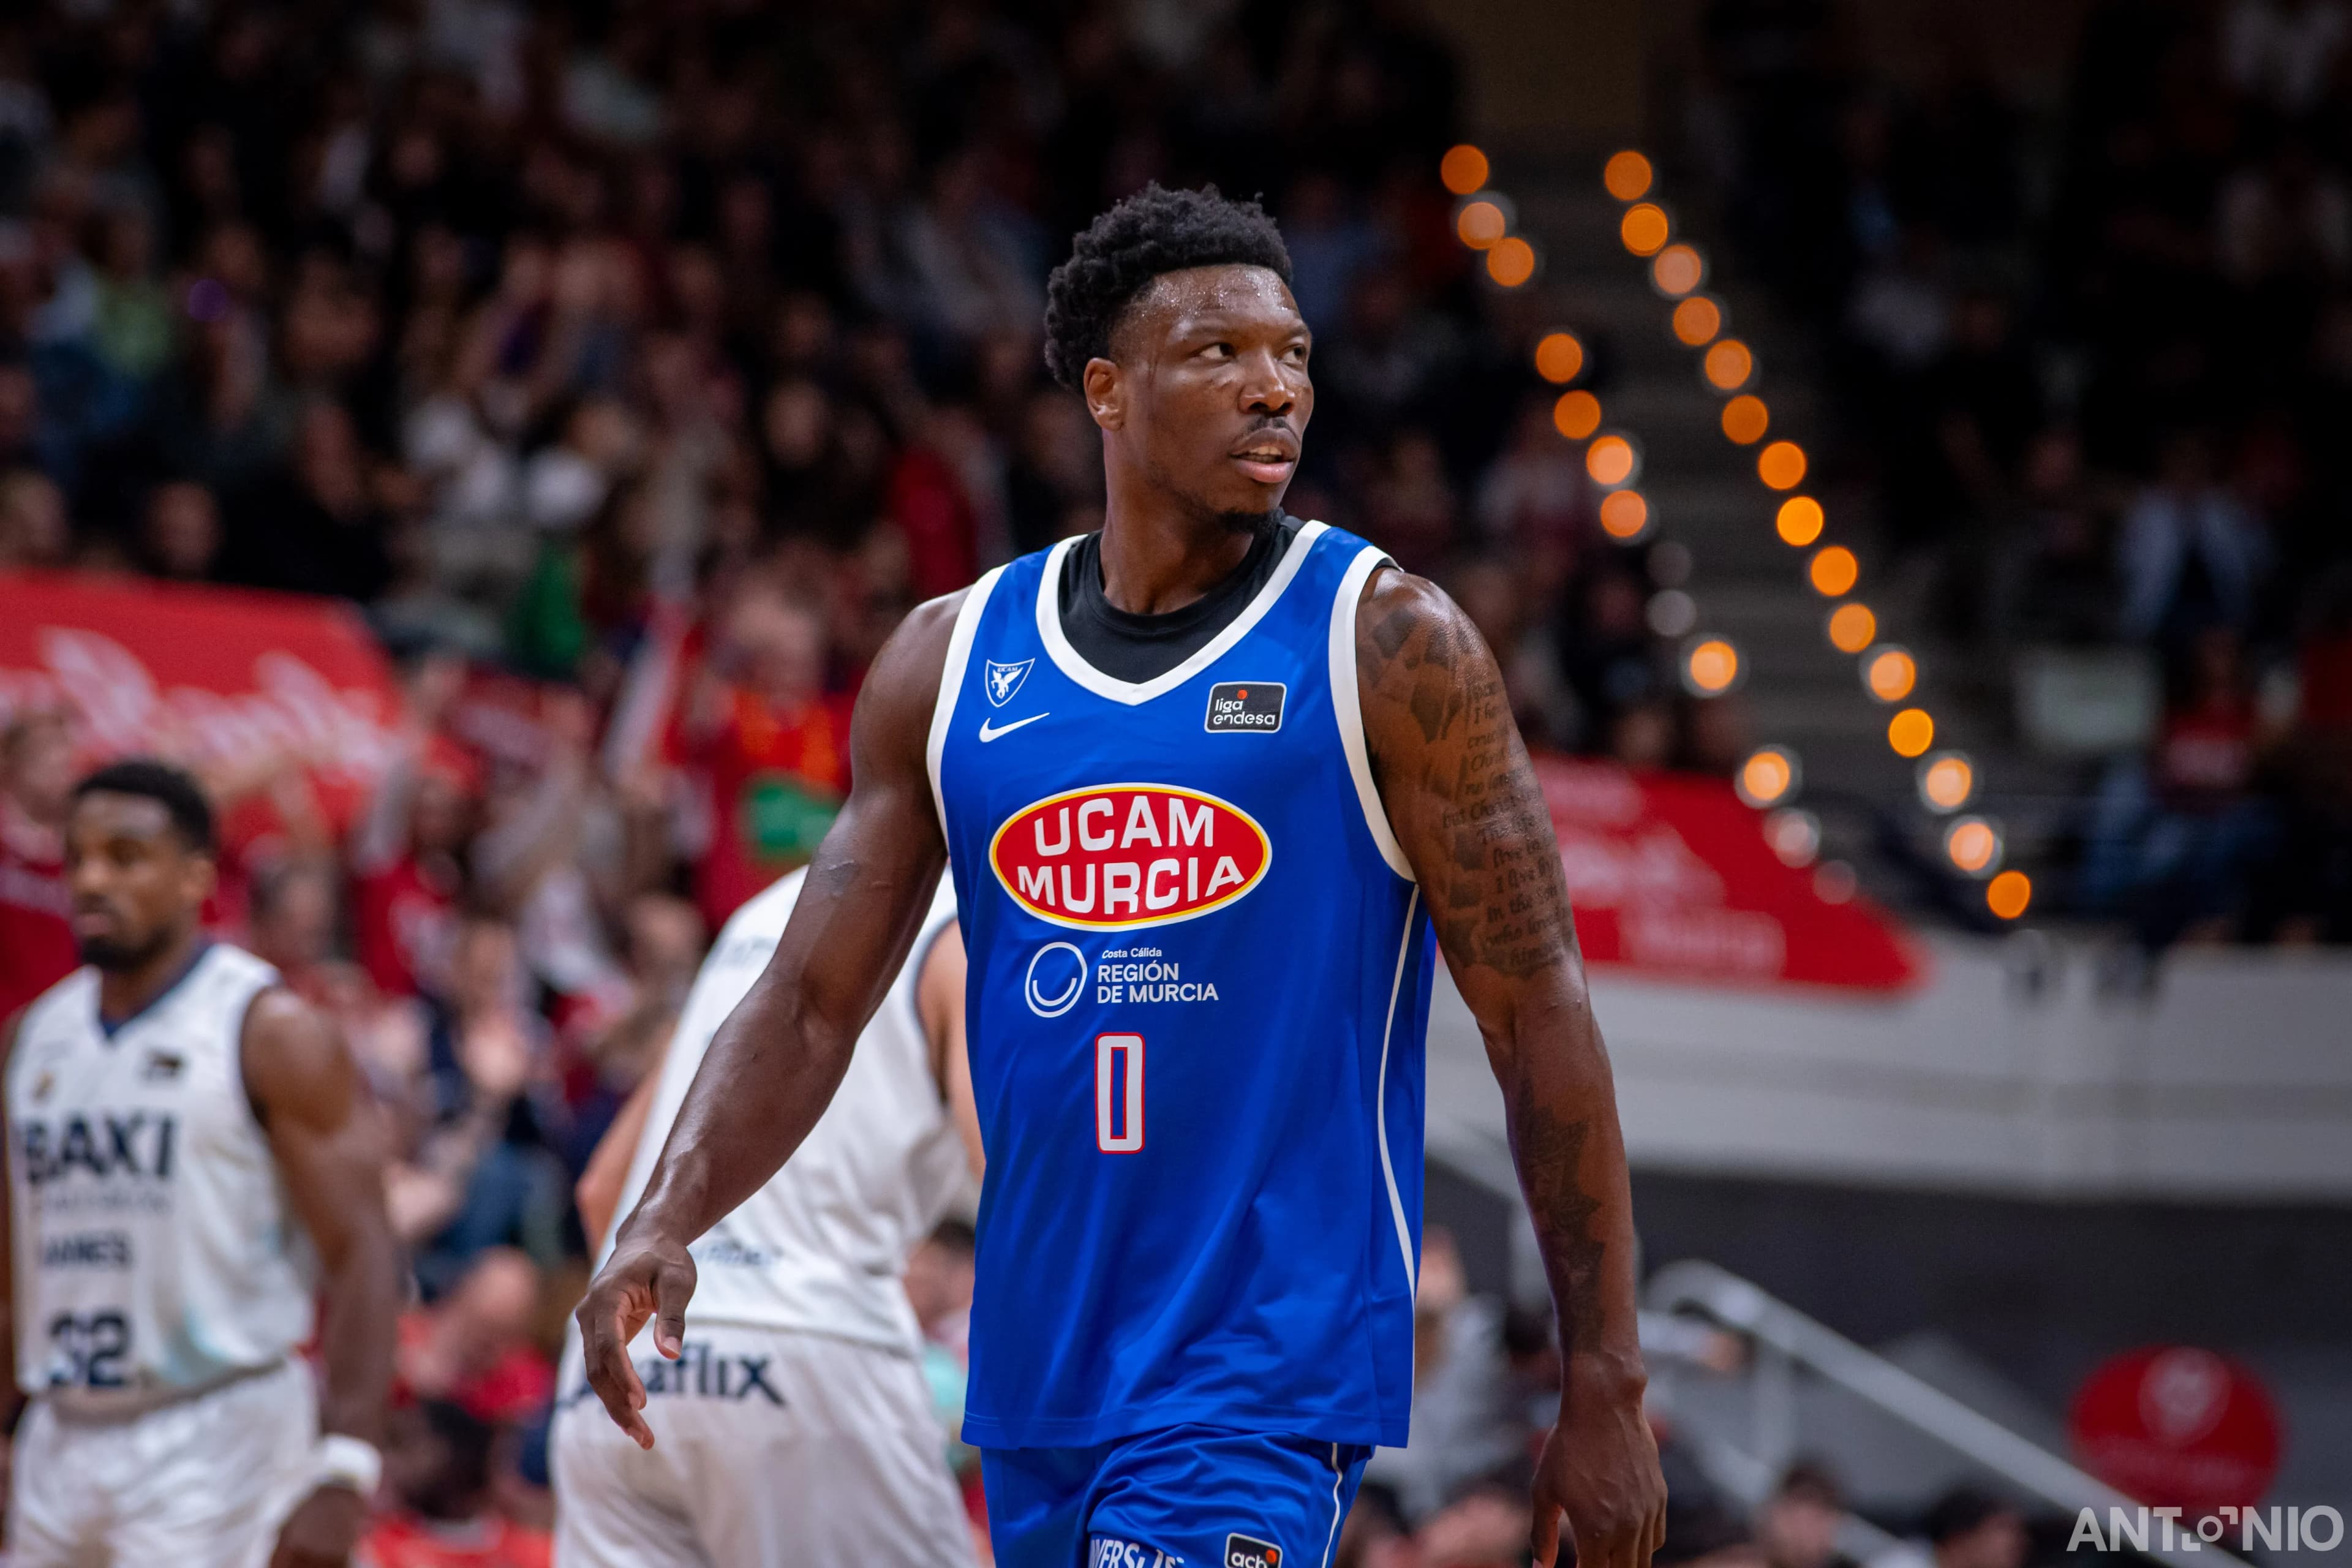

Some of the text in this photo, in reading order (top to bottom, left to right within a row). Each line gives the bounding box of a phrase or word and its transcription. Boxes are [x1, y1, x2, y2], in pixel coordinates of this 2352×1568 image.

[1213, 710, 1276, 725] endesa
[1215, 698, 1243, 714] liga
[1034, 795, 1215, 857] UCAM
[1017, 856, 1245, 915] MURCIA
[1101, 947, 1163, 959] Costa Cálida
[1097, 959, 1179, 983] REGIÓN
[1097, 982, 1219, 1004] DE MURCIA
[1094, 1031, 1146, 1155] 0
